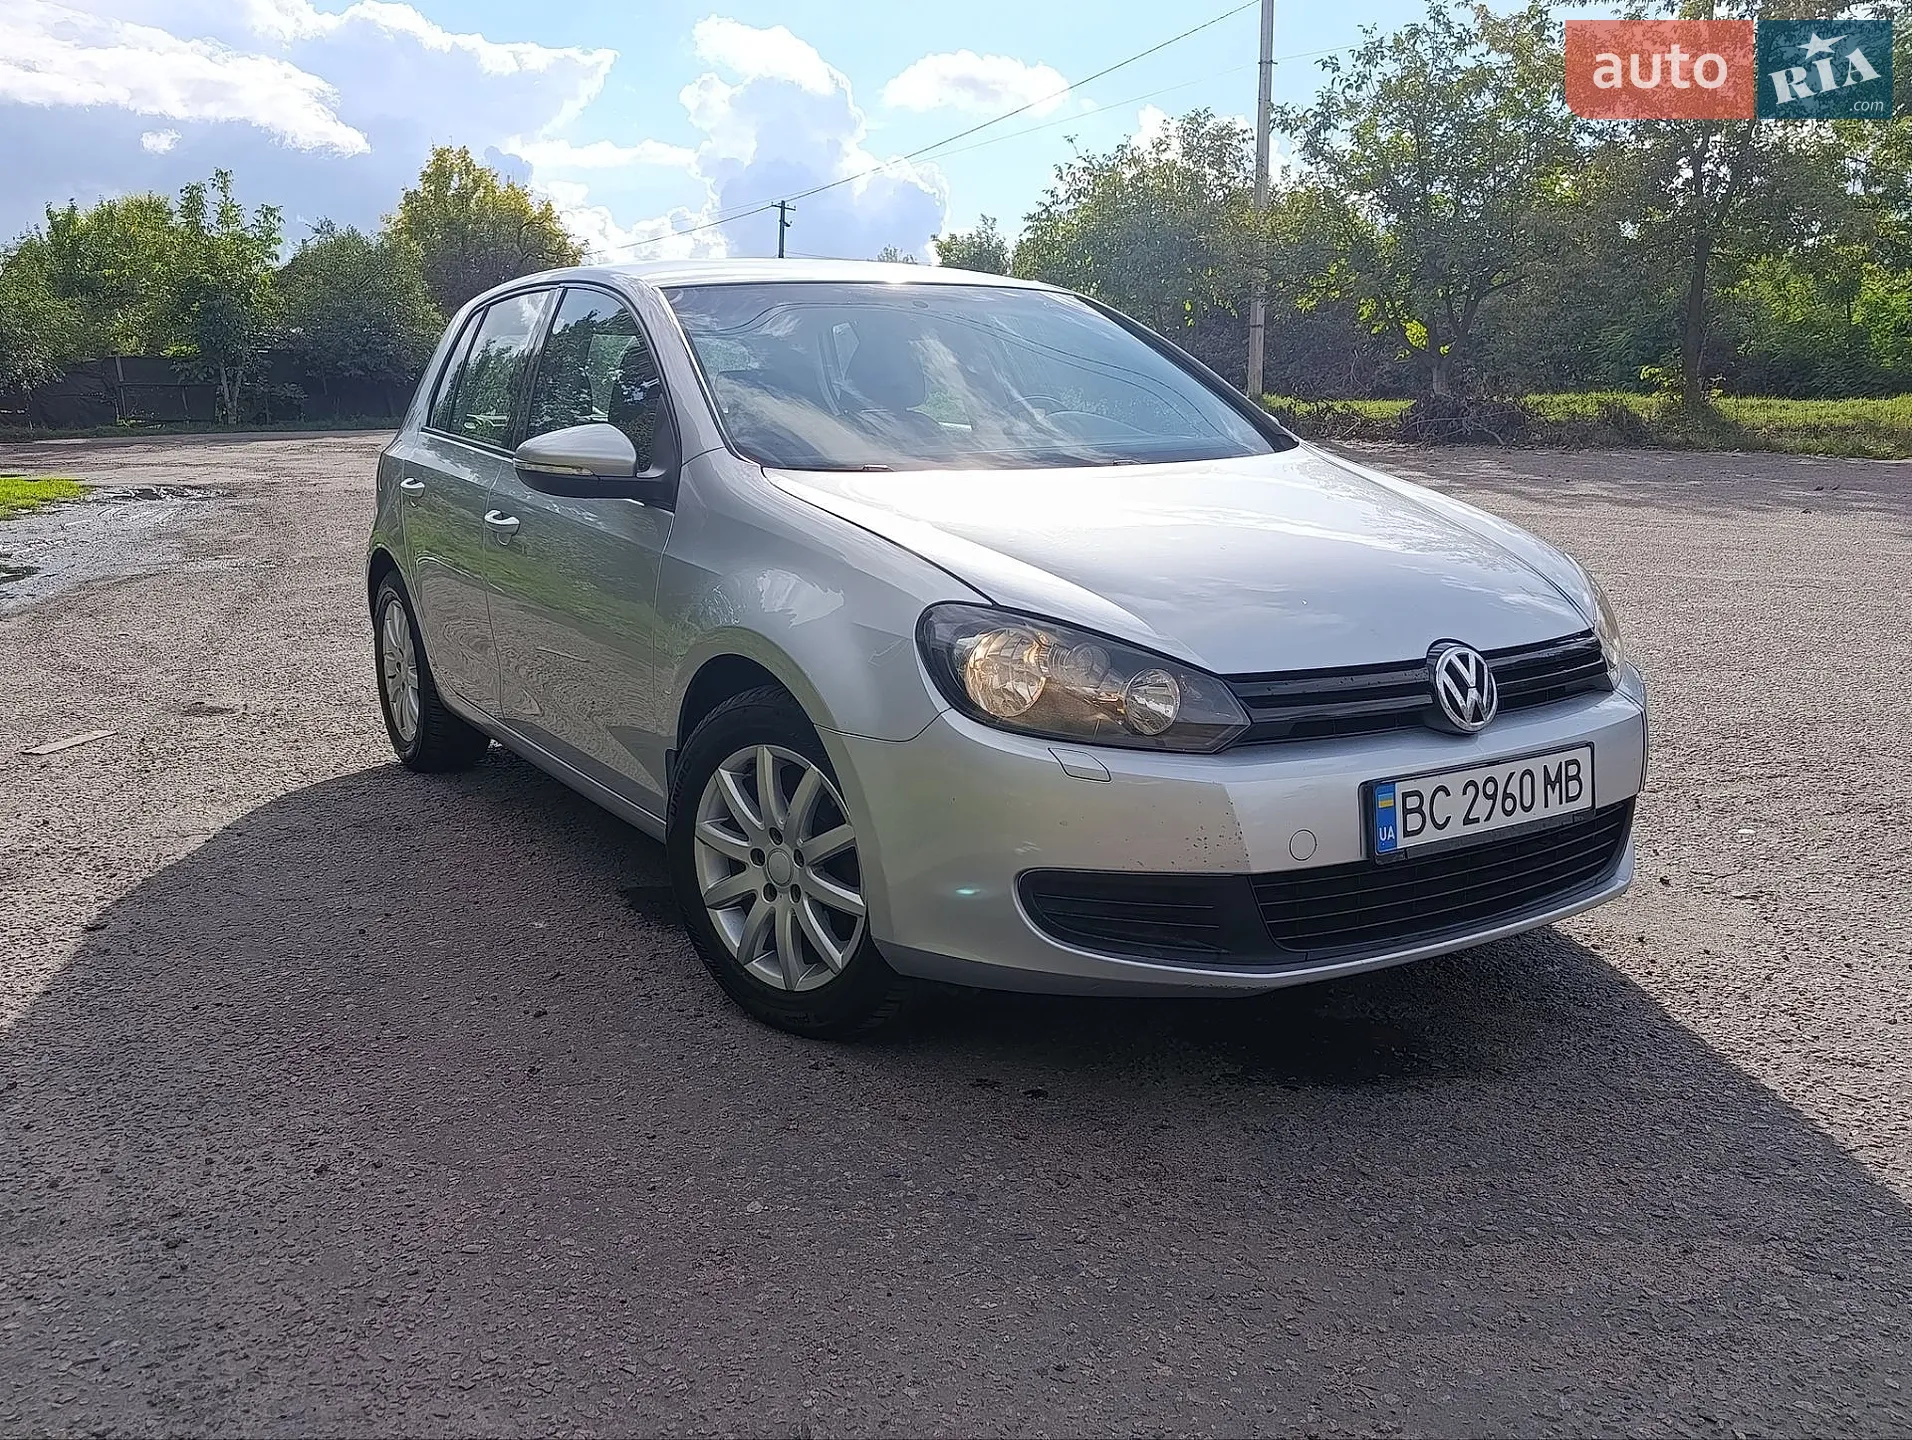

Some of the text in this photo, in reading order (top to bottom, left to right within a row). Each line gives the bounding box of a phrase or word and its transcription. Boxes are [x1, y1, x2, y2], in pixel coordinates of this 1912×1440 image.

[1402, 759, 1583, 838] BC 2960 MB
[1379, 825, 1395, 841] UA
